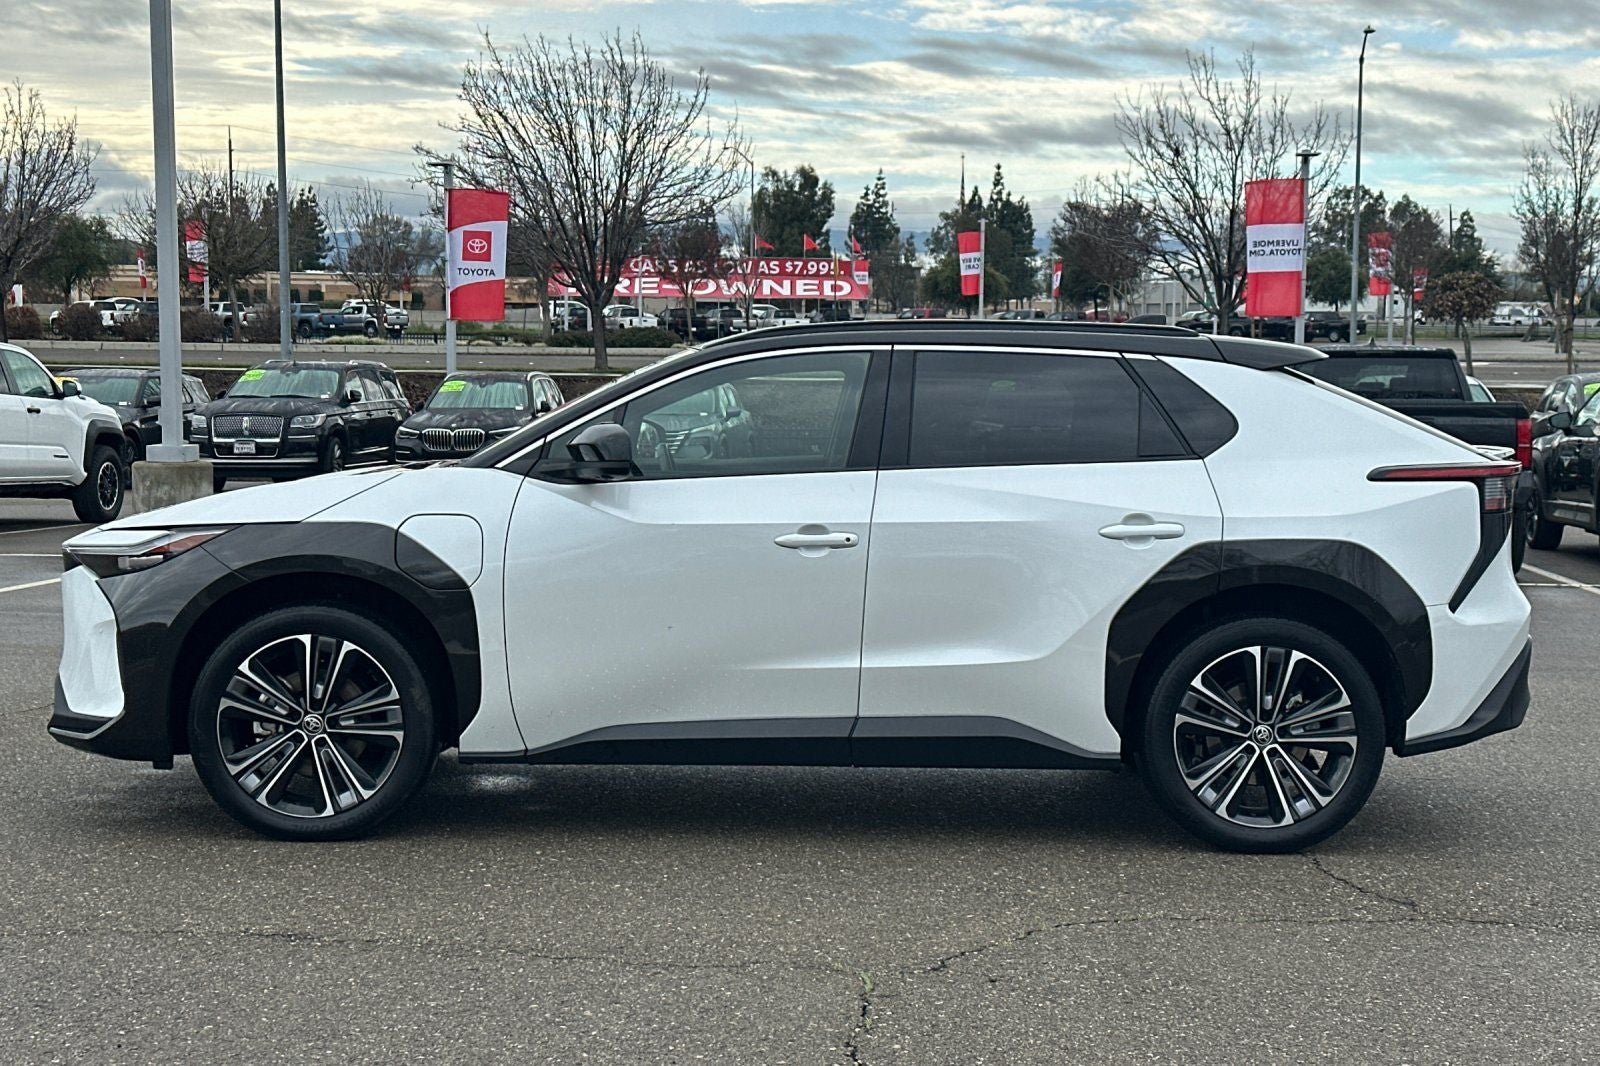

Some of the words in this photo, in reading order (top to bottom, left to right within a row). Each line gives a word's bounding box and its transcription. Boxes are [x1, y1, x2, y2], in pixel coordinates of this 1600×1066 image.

[457, 268, 496, 276] TOYOTA
[758, 260, 780, 274] AS
[567, 278, 852, 296] RE-OWNED
